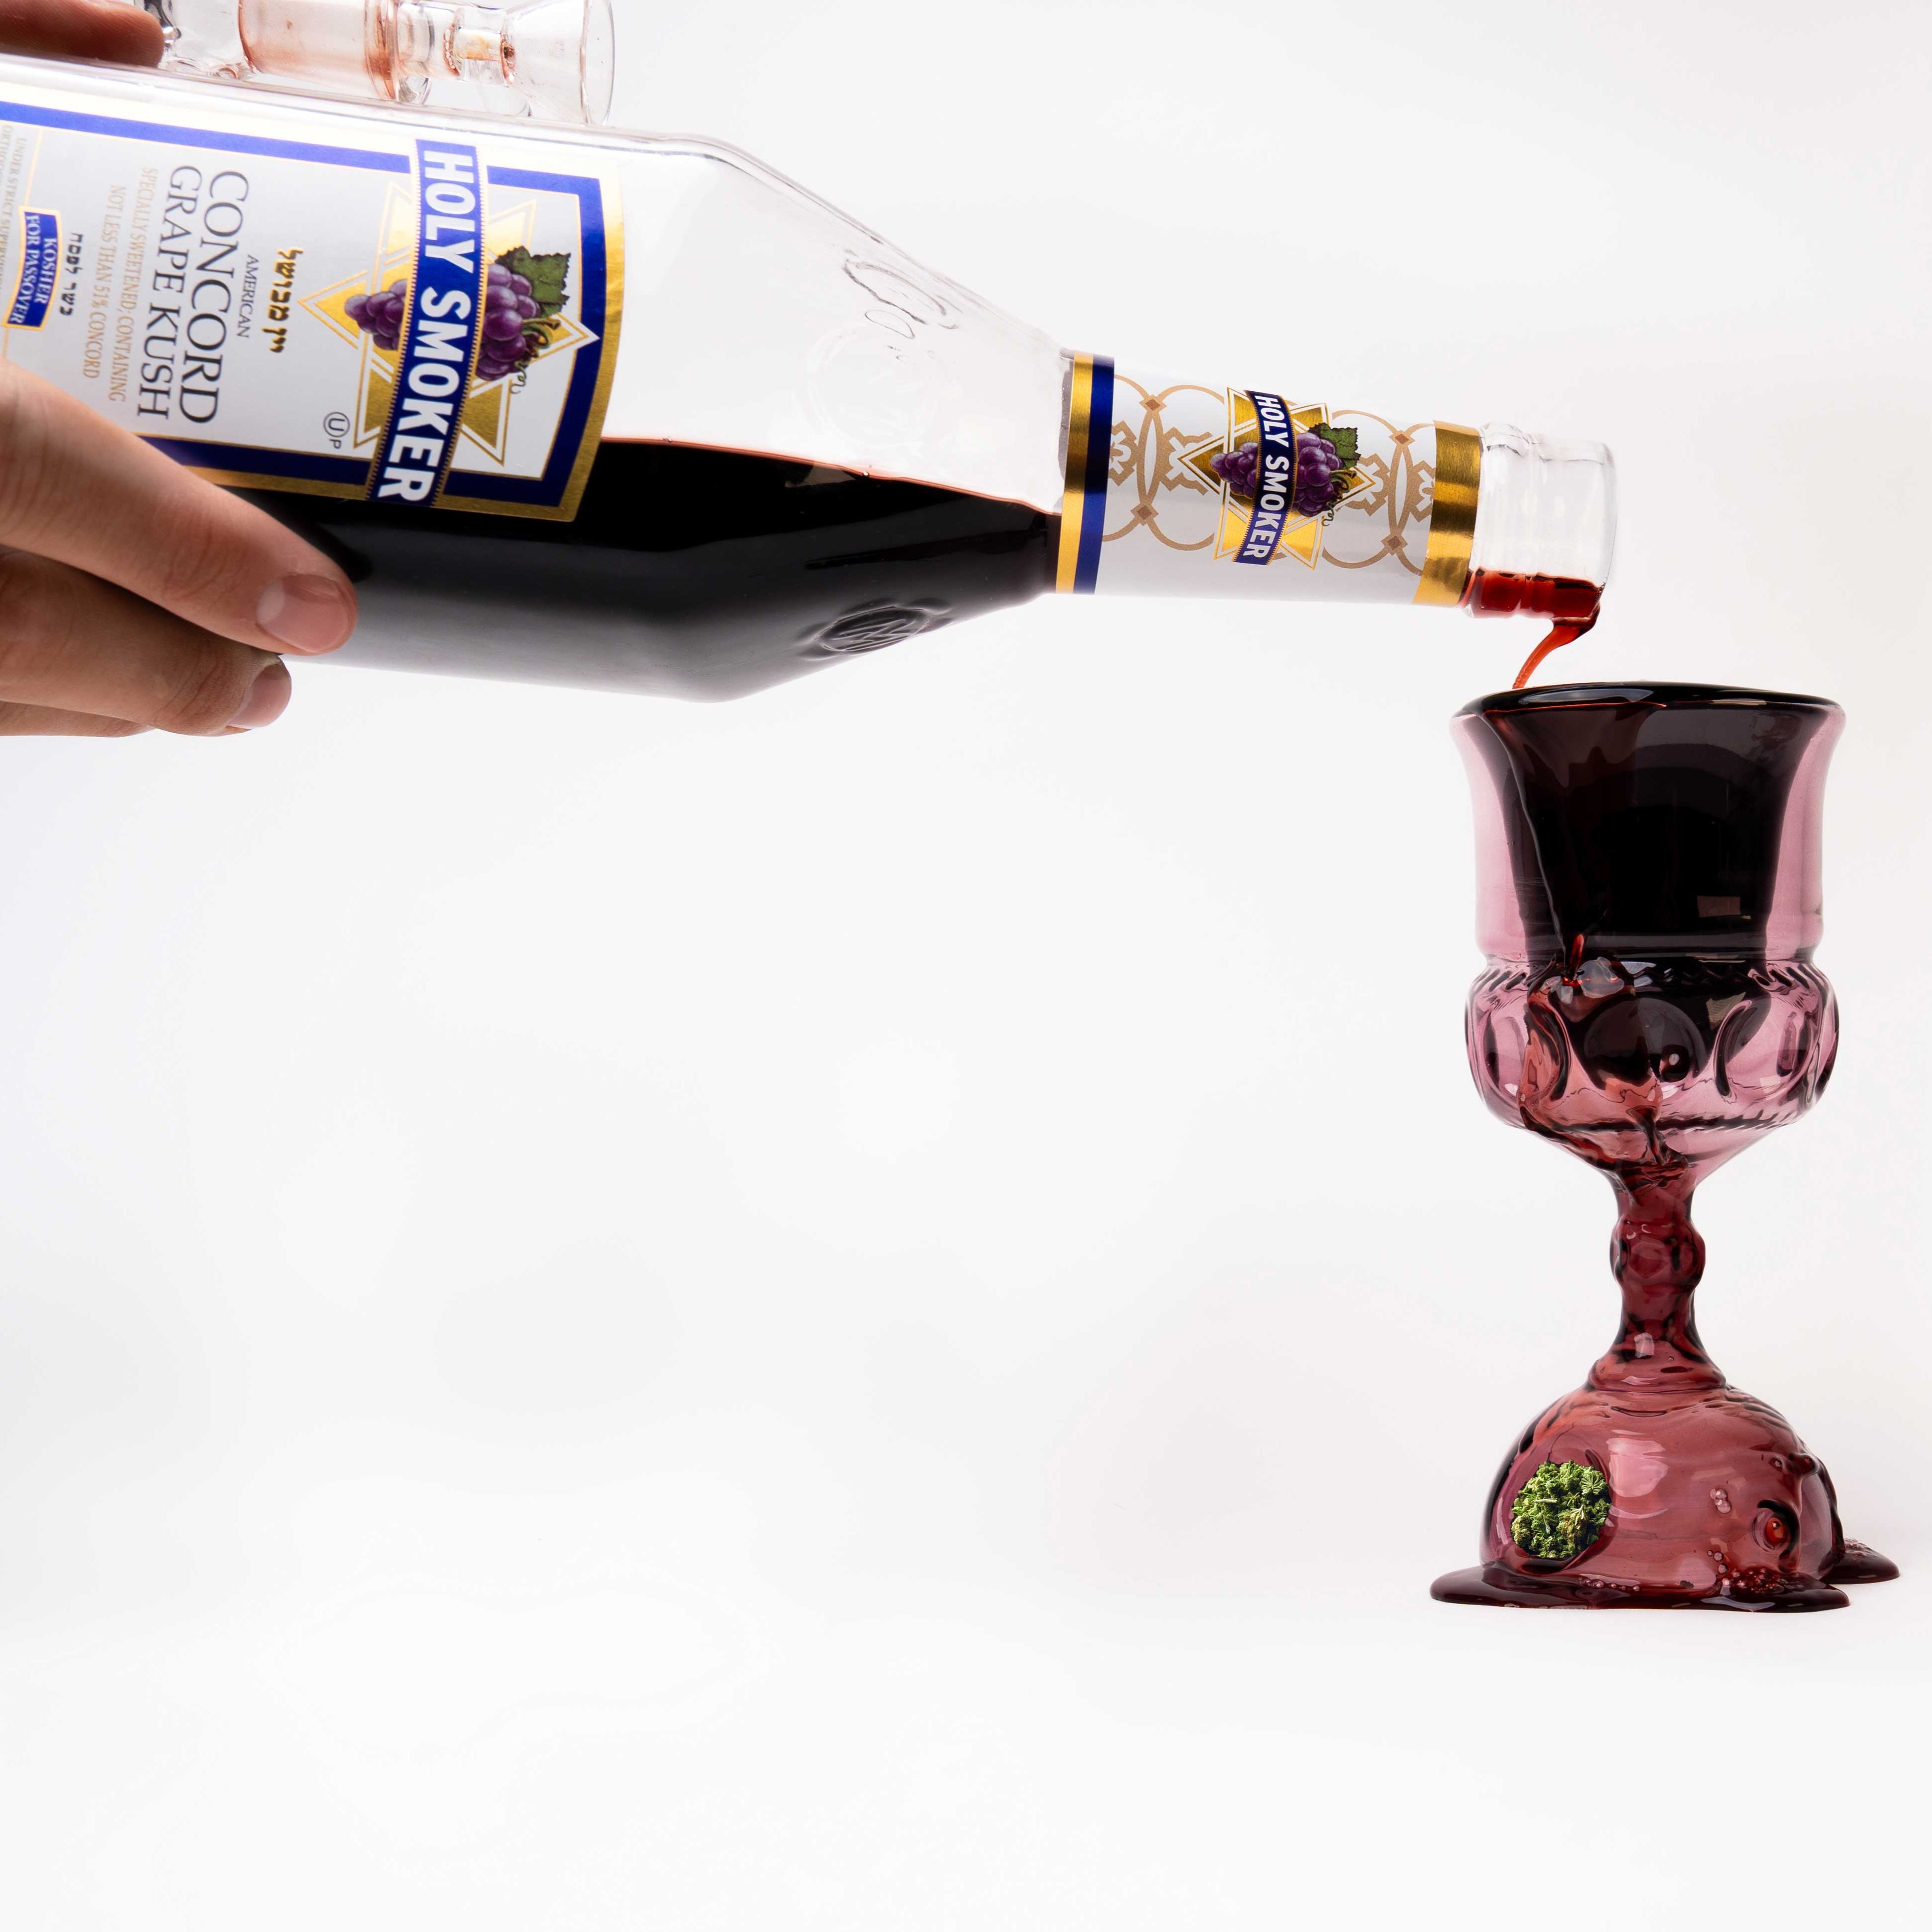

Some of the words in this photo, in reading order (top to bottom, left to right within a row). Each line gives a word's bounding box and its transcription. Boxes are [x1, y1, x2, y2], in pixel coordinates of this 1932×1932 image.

[26, 215, 40, 246] FOR
[101, 214, 122, 243] LESS
[107, 184, 126, 212] NOT
[133, 167, 159, 232] SPECIALLY
[153, 165, 202, 294] GRAPE
[424, 150, 476, 274] HOLY
[10, 249, 40, 323] PASSOVER
[33, 238, 57, 304] KOSHER
[91, 285, 111, 308] 51%
[95, 246, 116, 283] THAN
[179, 171, 249, 423] CONCORD
[237, 254, 260, 338] AMERICAN
[83, 312, 107, 378] CONCORD
[108, 316, 135, 402] CONTAINING
[137, 303, 181, 420] KUSH
[377, 287, 472, 501] SMOKER
[1255, 395, 1289, 448] HOLY
[1243, 454, 1289, 559] SMOKER
